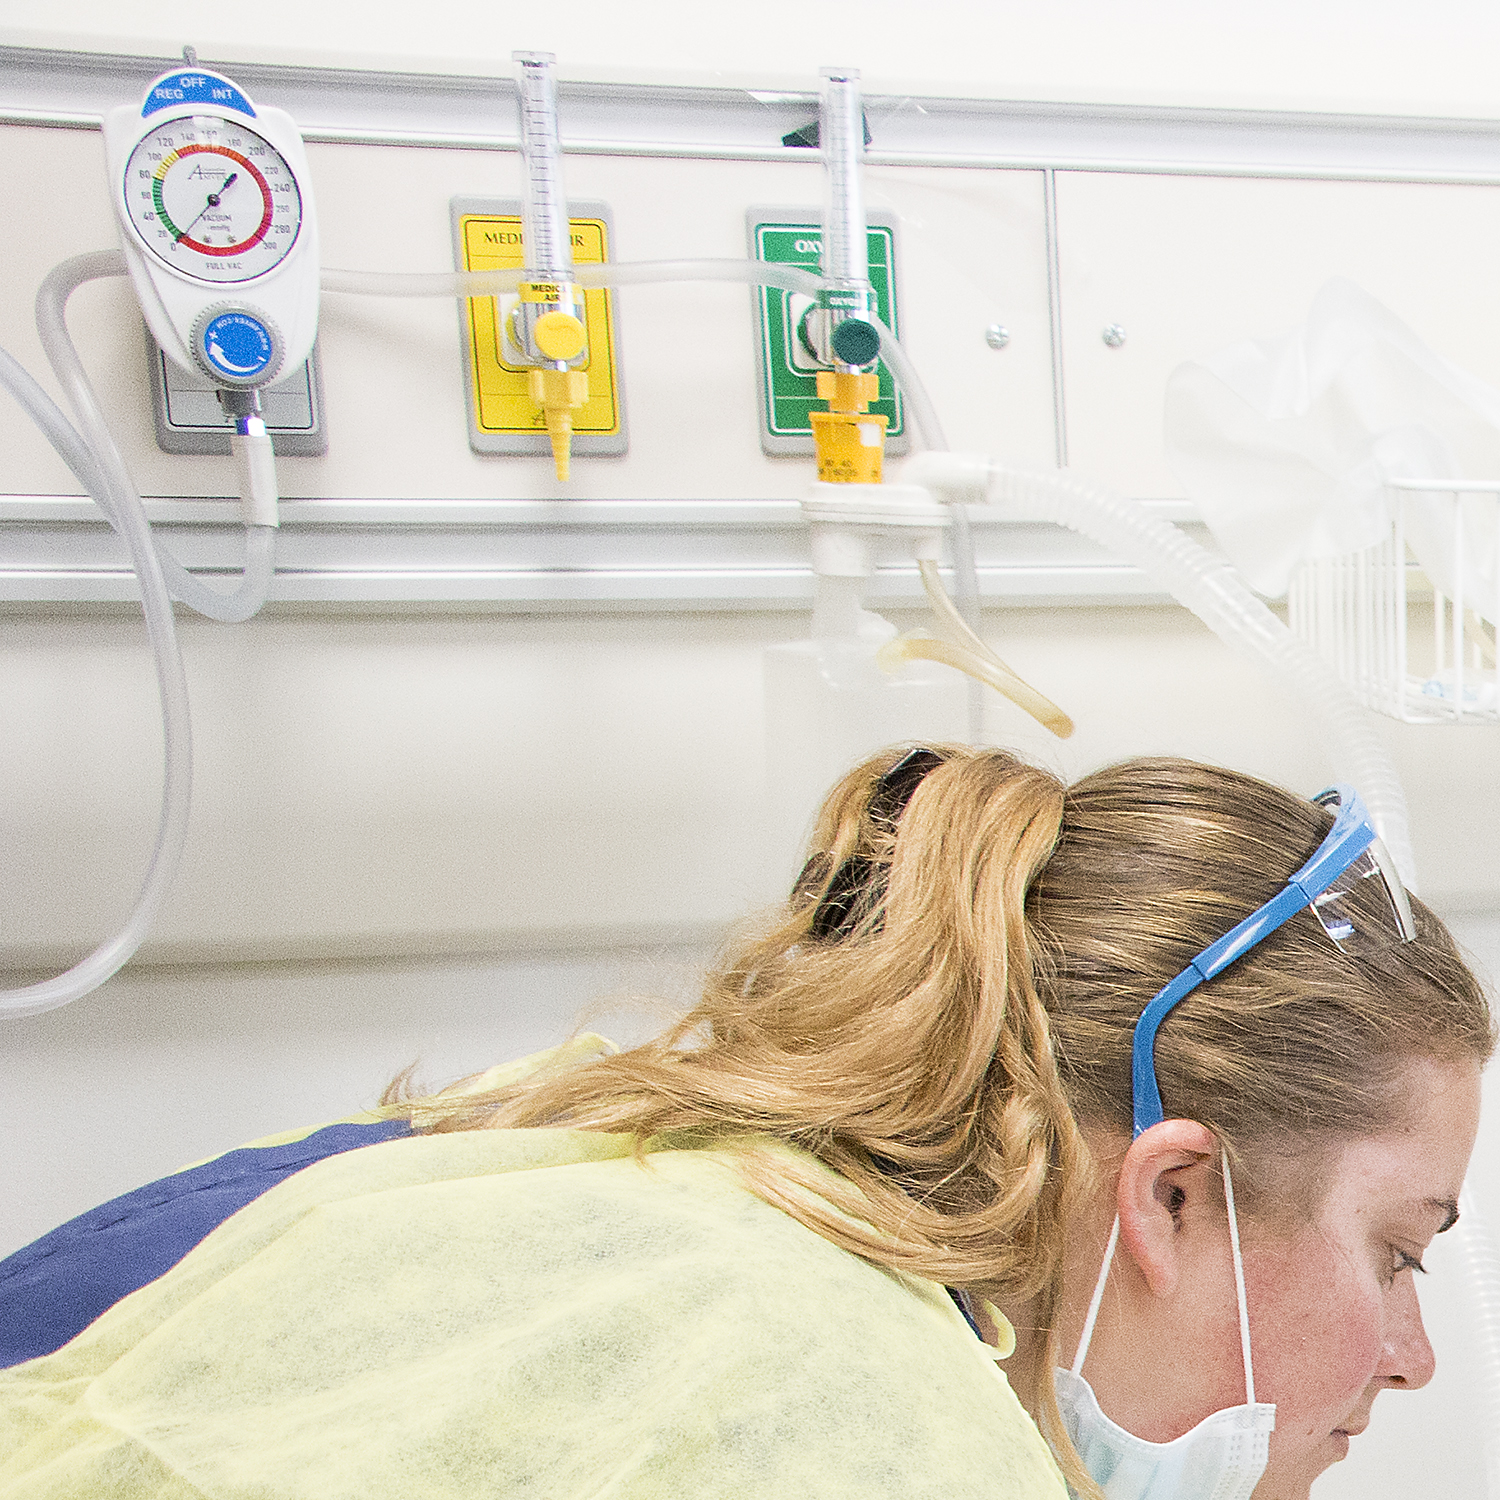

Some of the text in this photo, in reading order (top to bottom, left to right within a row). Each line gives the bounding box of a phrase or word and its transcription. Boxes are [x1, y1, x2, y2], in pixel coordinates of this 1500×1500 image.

[180, 77, 206, 88] OFF
[155, 89, 184, 100] REG
[212, 88, 233, 100] INT
[158, 137, 174, 147] 120
[249, 146, 266, 157] 200
[148, 152, 162, 161] 100
[139, 169, 151, 179] 80
[264, 166, 279, 175] 220
[274, 183, 291, 193] 240
[143, 212, 154, 221] 40
[202, 214, 232, 222] VACUUM
[158, 230, 168, 238] 20
[484, 232, 524, 245] MEDI
[170, 242, 177, 251] 0
[263, 241, 278, 250] 300
[205, 262, 243, 271] FULL VAC
[545, 293, 561, 301] AIR
